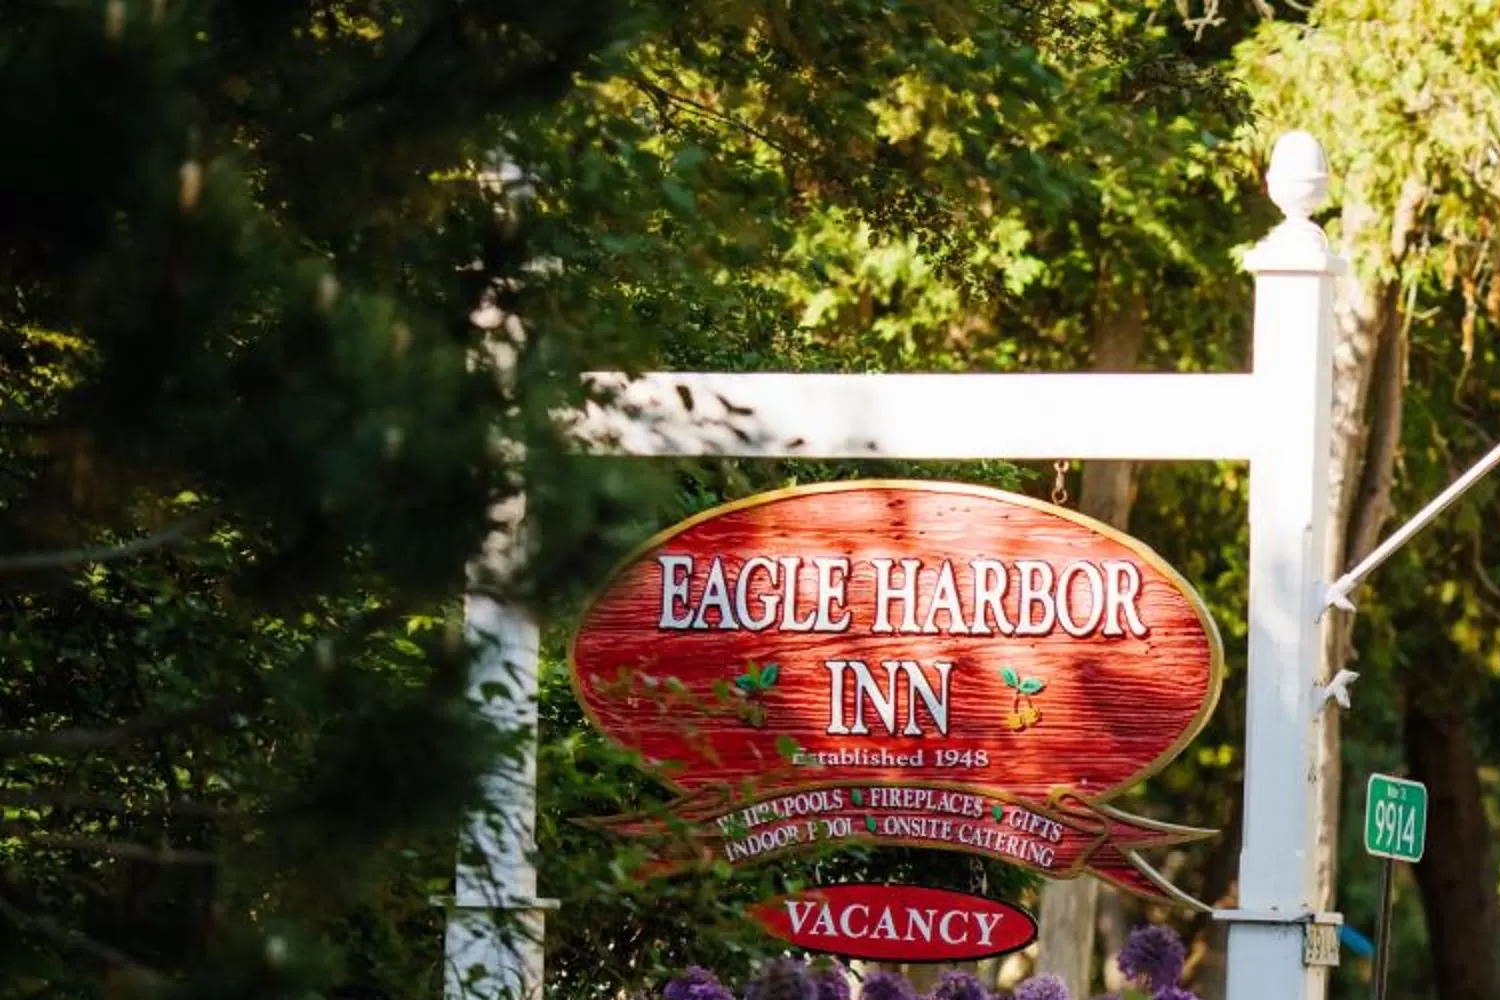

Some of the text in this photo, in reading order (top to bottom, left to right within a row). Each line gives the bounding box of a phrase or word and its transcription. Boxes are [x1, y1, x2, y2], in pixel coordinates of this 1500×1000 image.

[657, 554, 1149, 639] EAGLE HARBOR
[825, 660, 953, 737] INN
[935, 749, 989, 768] 1948
[725, 824, 800, 862] INDOOR
[884, 815, 952, 840] ONSITE
[958, 823, 1055, 868] CATERING
[870, 787, 984, 818] FIREPLACES
[1009, 808, 1063, 843] GIFTS
[1375, 799, 1416, 854] 9914
[784, 900, 1004, 946] VACANCY
